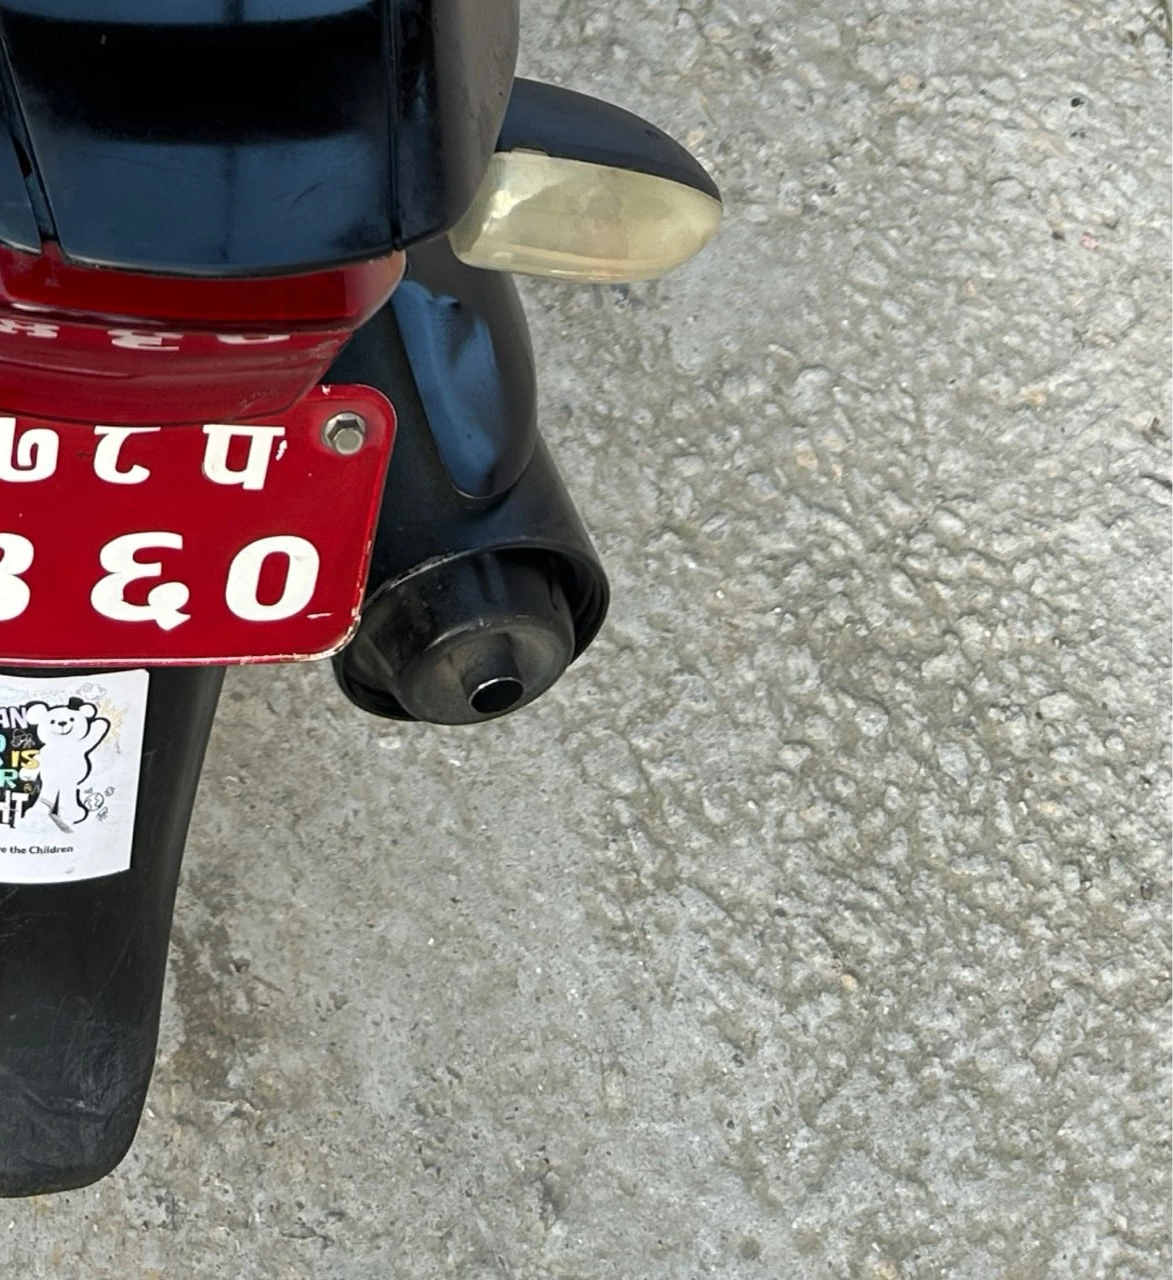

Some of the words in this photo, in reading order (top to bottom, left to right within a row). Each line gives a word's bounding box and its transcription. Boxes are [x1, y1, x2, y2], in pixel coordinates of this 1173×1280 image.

[202, 424, 286, 490] प
[11, 749, 41, 770] IS
[9, 843, 27, 855] the
[29, 844, 74, 856] Children
